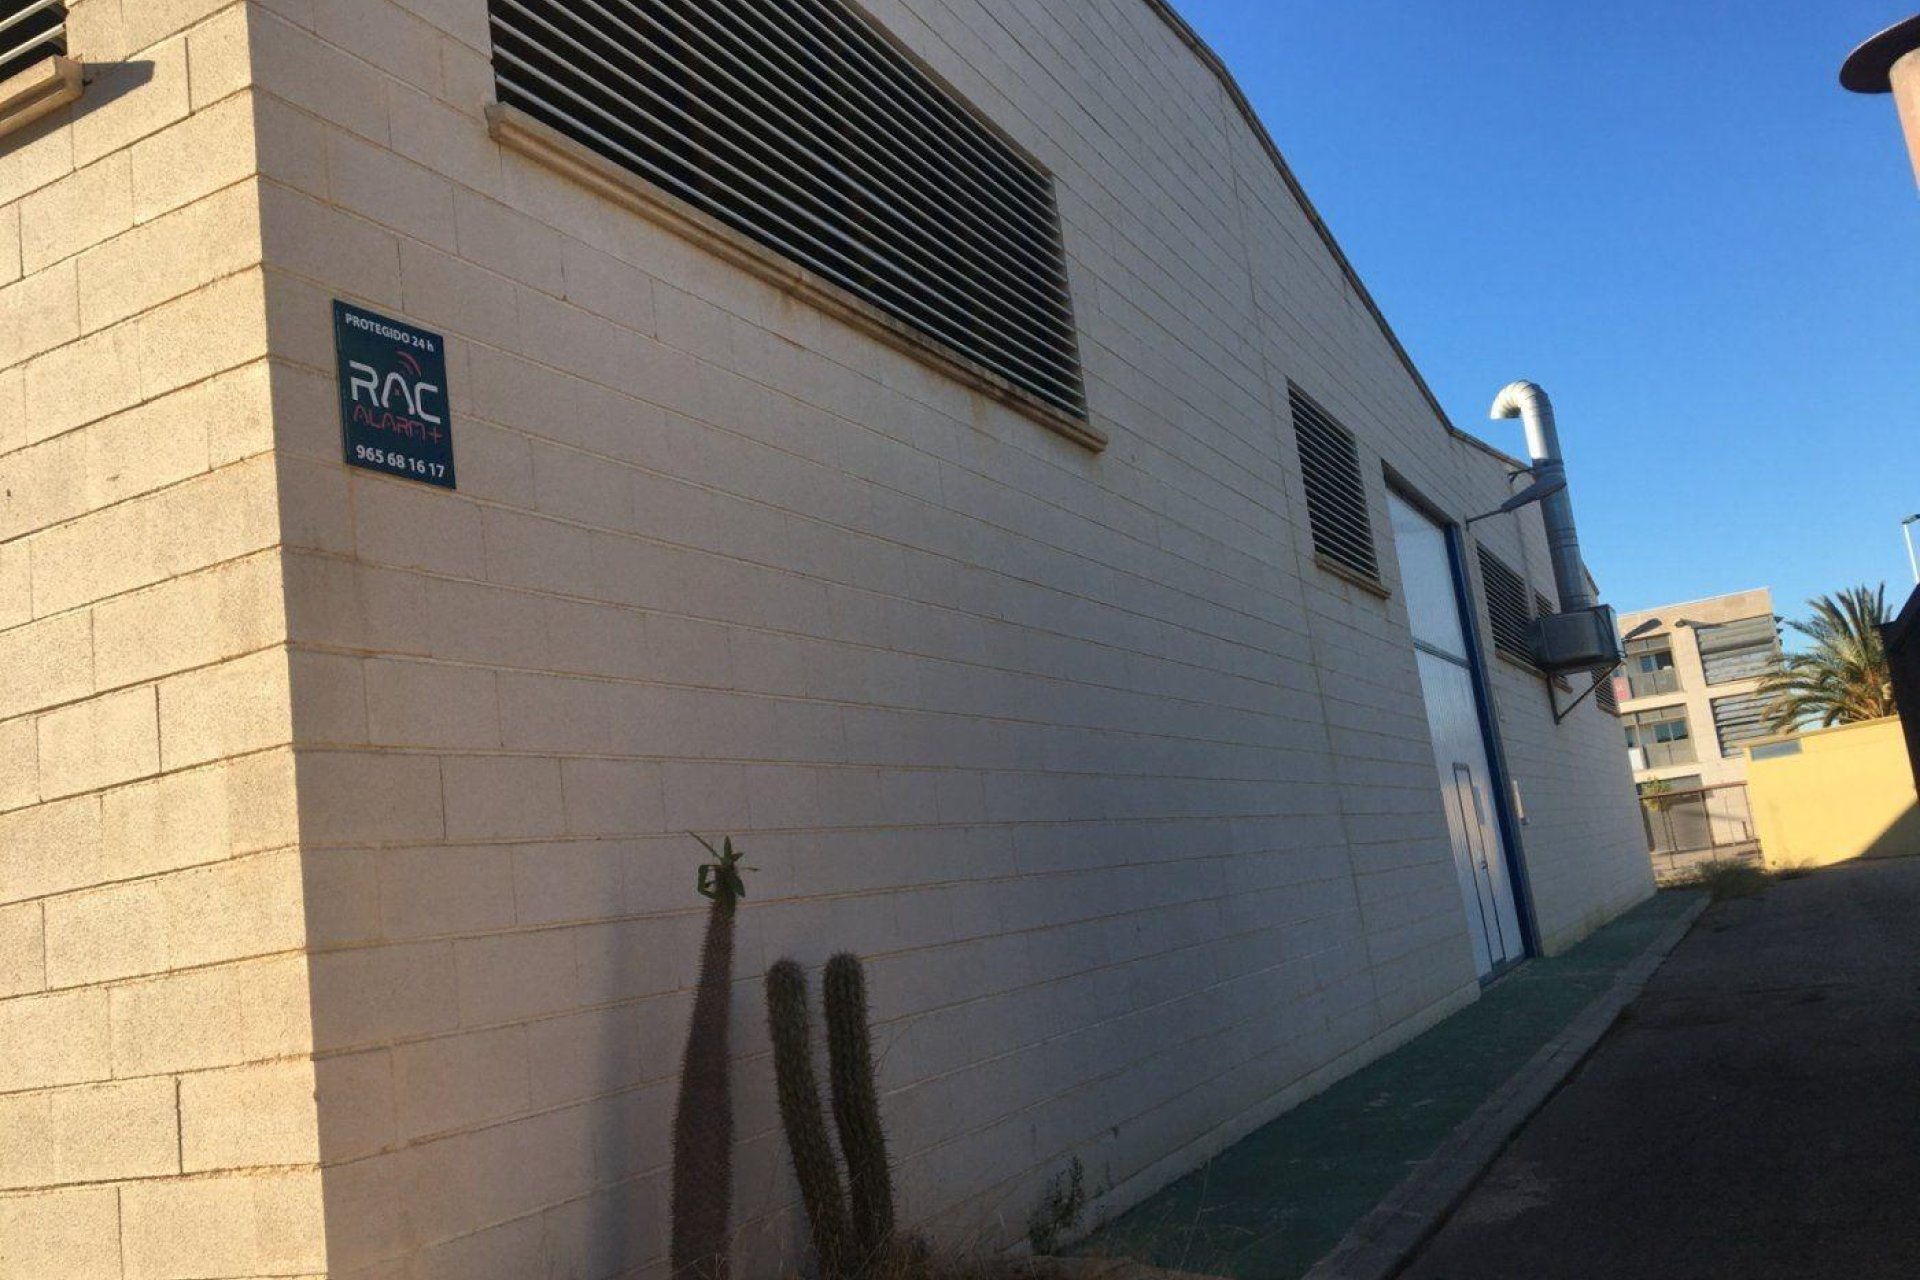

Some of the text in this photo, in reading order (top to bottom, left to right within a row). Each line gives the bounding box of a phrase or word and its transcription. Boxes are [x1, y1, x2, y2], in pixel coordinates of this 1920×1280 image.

[345, 313, 410, 344] PROTEGIDO
[411, 335, 425, 350] 24
[349, 359, 441, 424] RAC
[355, 444, 445, 479] 965 68 16 17
